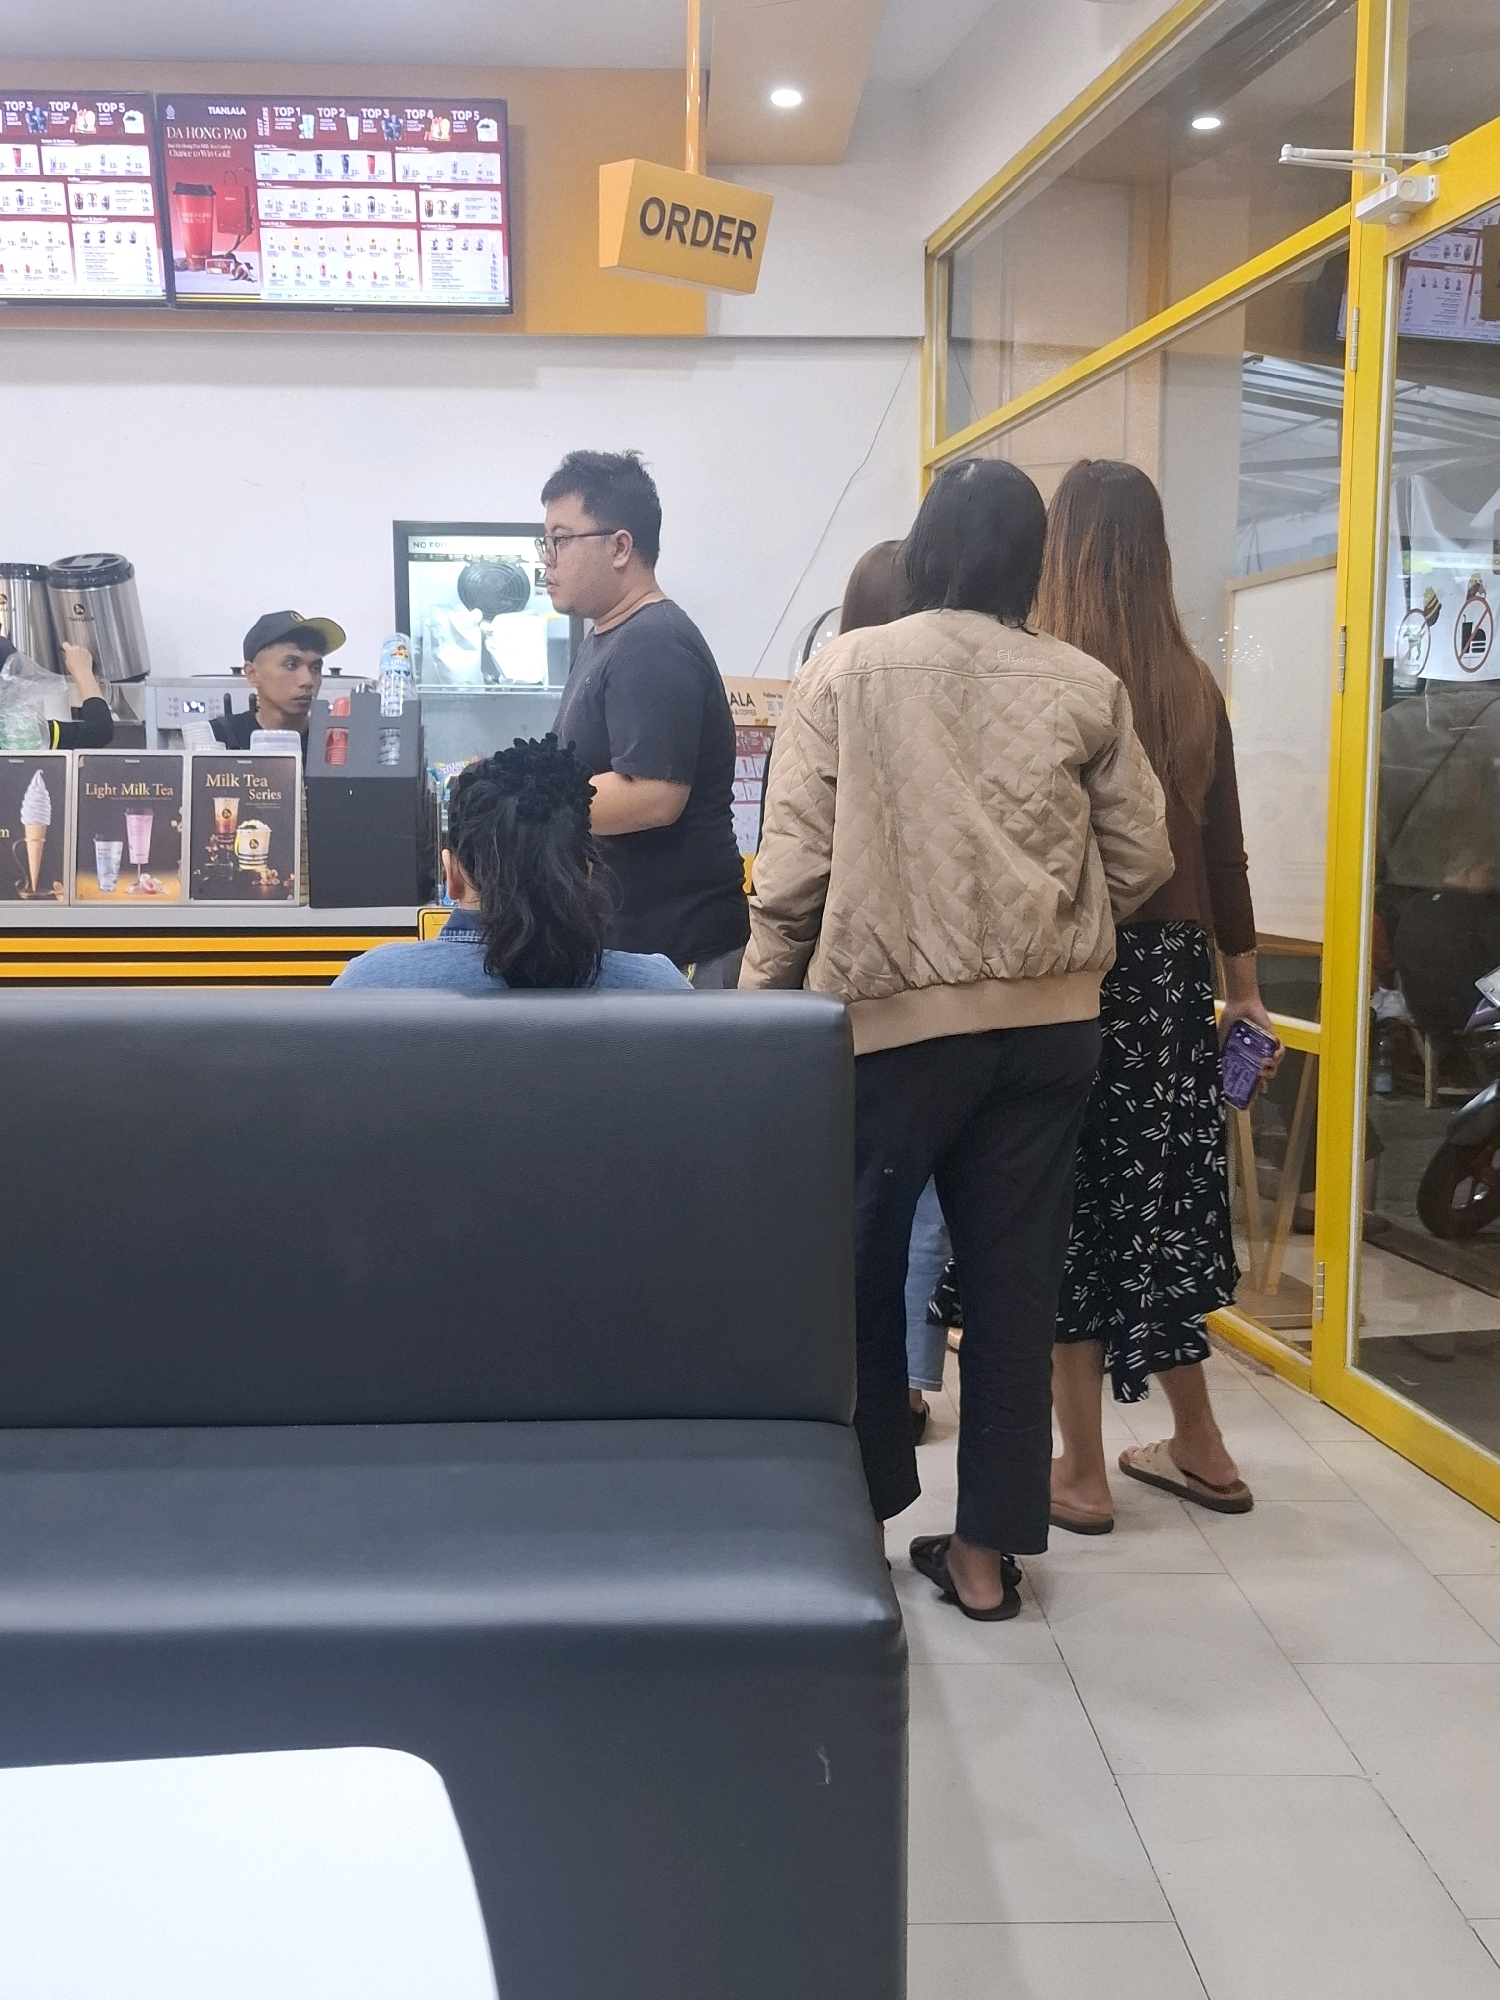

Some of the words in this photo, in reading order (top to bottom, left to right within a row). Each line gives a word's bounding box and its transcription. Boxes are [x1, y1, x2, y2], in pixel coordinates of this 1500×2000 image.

[3, 101, 25, 111] TOP
[26, 101, 34, 111] 3
[49, 101, 71, 112] TOP
[71, 101, 79, 111] 4
[96, 102, 118, 113] TOP
[118, 102, 126, 113] 5
[208, 106, 247, 115] TIANLALA
[273, 107, 294, 117] TOP
[295, 106, 301, 117] 1
[316, 107, 338, 118] TOP
[339, 107, 346, 118] 2
[360, 108, 382, 119] TOP
[383, 108, 390, 119] 3
[405, 109, 426, 120] TOP
[427, 109, 434, 119] 4
[450, 110, 472, 121] TOP
[473, 110, 480, 121] 5
[166, 126, 183, 139] DA
[186, 126, 221, 139] HONG
[224, 127, 247, 140] PAO
[639, 196, 757, 260] ORDER
[413, 541, 427, 549] NO
[205, 773, 240, 787] Milk
[243, 774, 268, 787] Tea
[85, 783, 117, 799] Light
[121, 783, 150, 796] Milk
[152, 783, 174, 796] Tea
[249, 788, 282, 800] Series
